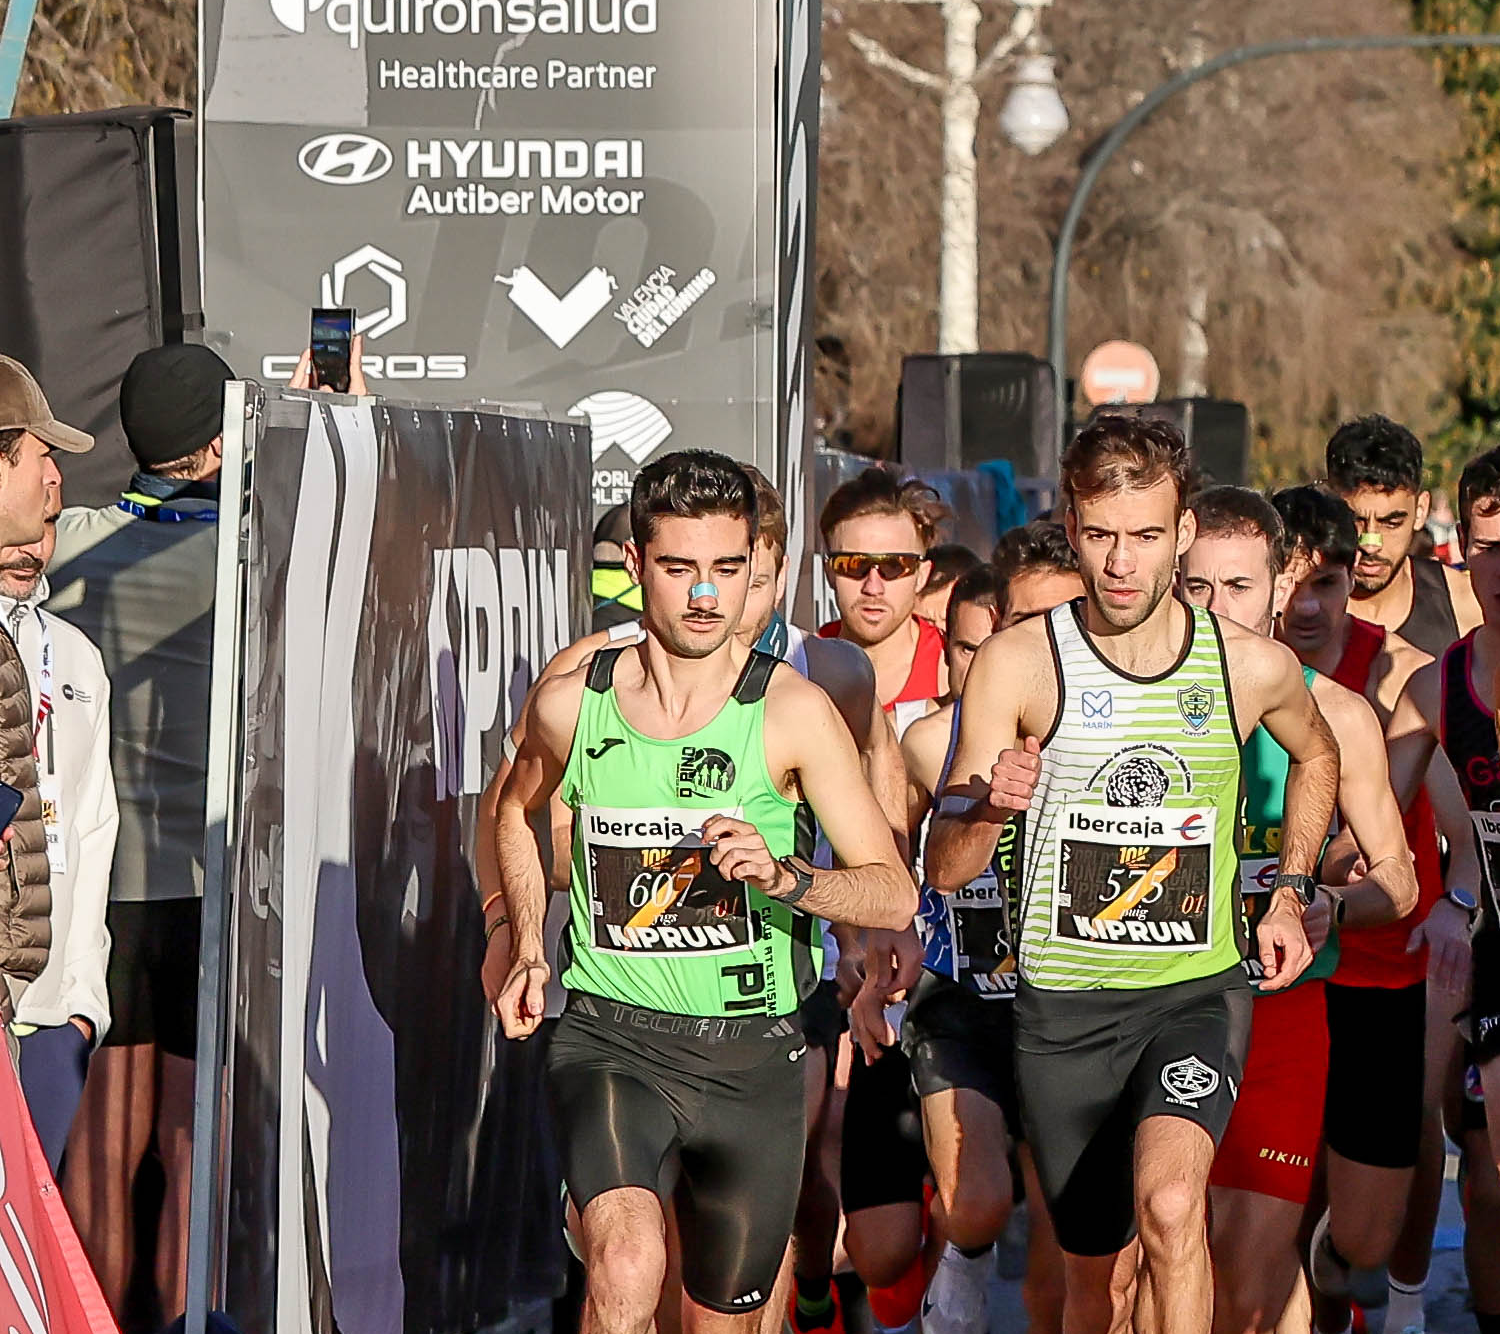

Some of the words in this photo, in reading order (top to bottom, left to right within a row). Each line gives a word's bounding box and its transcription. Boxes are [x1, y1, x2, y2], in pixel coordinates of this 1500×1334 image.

[379, 60, 538, 90] Healthcare
[548, 61, 657, 90] Partner
[407, 139, 643, 179] HYUNDAI
[407, 185, 534, 216] Autiber
[541, 186, 644, 216] Motor
[262, 354, 467, 380] CROS
[590, 815, 685, 840] Ibercaja
[1069, 813, 1164, 838] Ibercaja
[1119, 847, 1151, 865] 10K
[629, 872, 695, 908] 607
[1098, 868, 1169, 904] 575
[606, 923, 737, 949] KIPRUN
[1072, 915, 1196, 942] KIPRUN
[609, 1002, 751, 1039] TECHFIT
